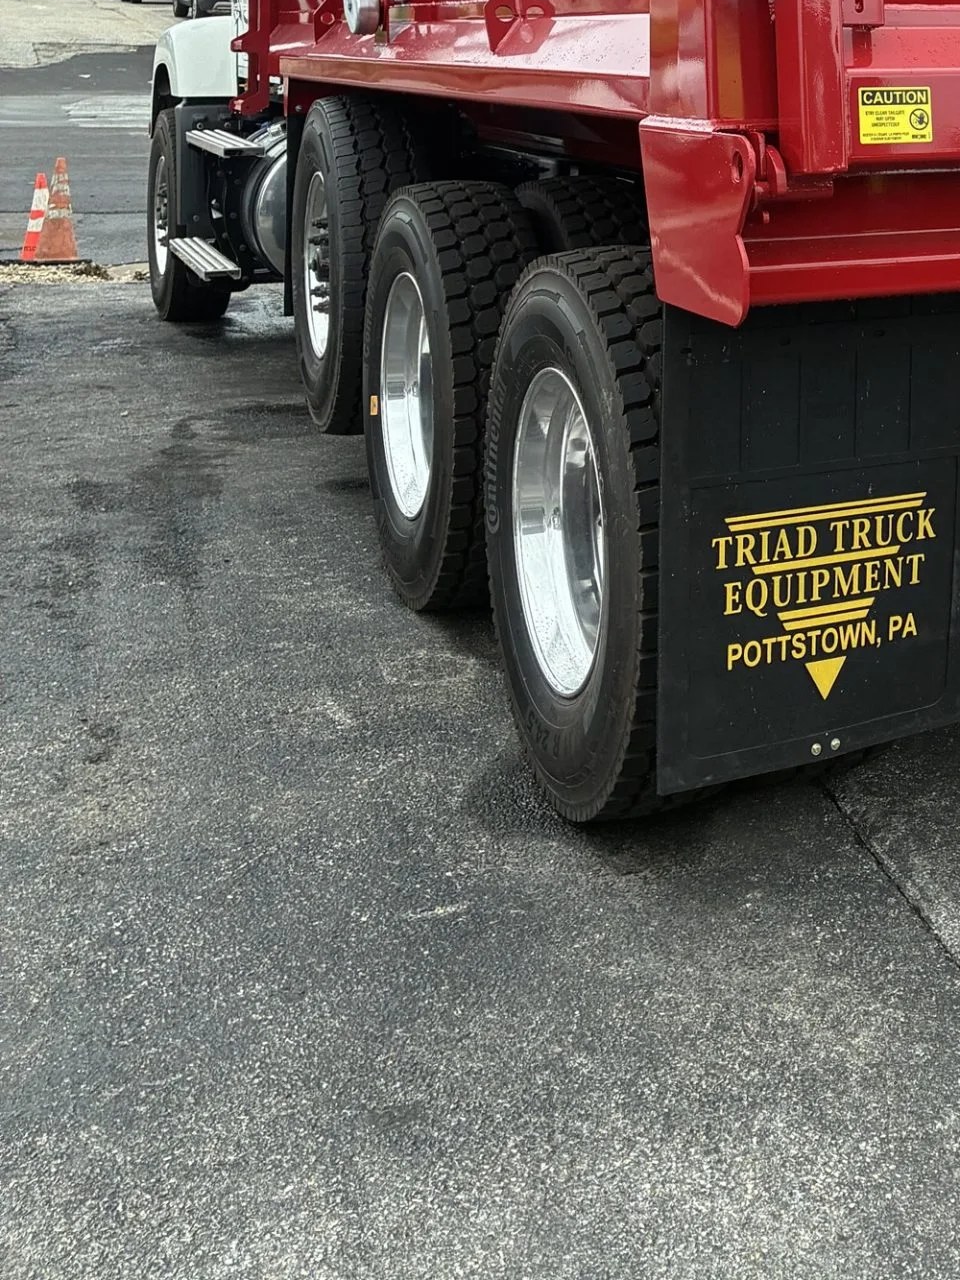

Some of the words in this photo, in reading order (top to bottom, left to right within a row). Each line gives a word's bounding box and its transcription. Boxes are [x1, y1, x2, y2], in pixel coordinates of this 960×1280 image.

[863, 91, 927, 104] CAUTION
[485, 376, 507, 535] Continental
[711, 525, 817, 569] TRIAD
[829, 508, 936, 552] TRUCK
[723, 553, 925, 617] EQUIPMENT
[727, 620, 881, 671] POTTSTOWN,
[888, 612, 918, 641] PA
